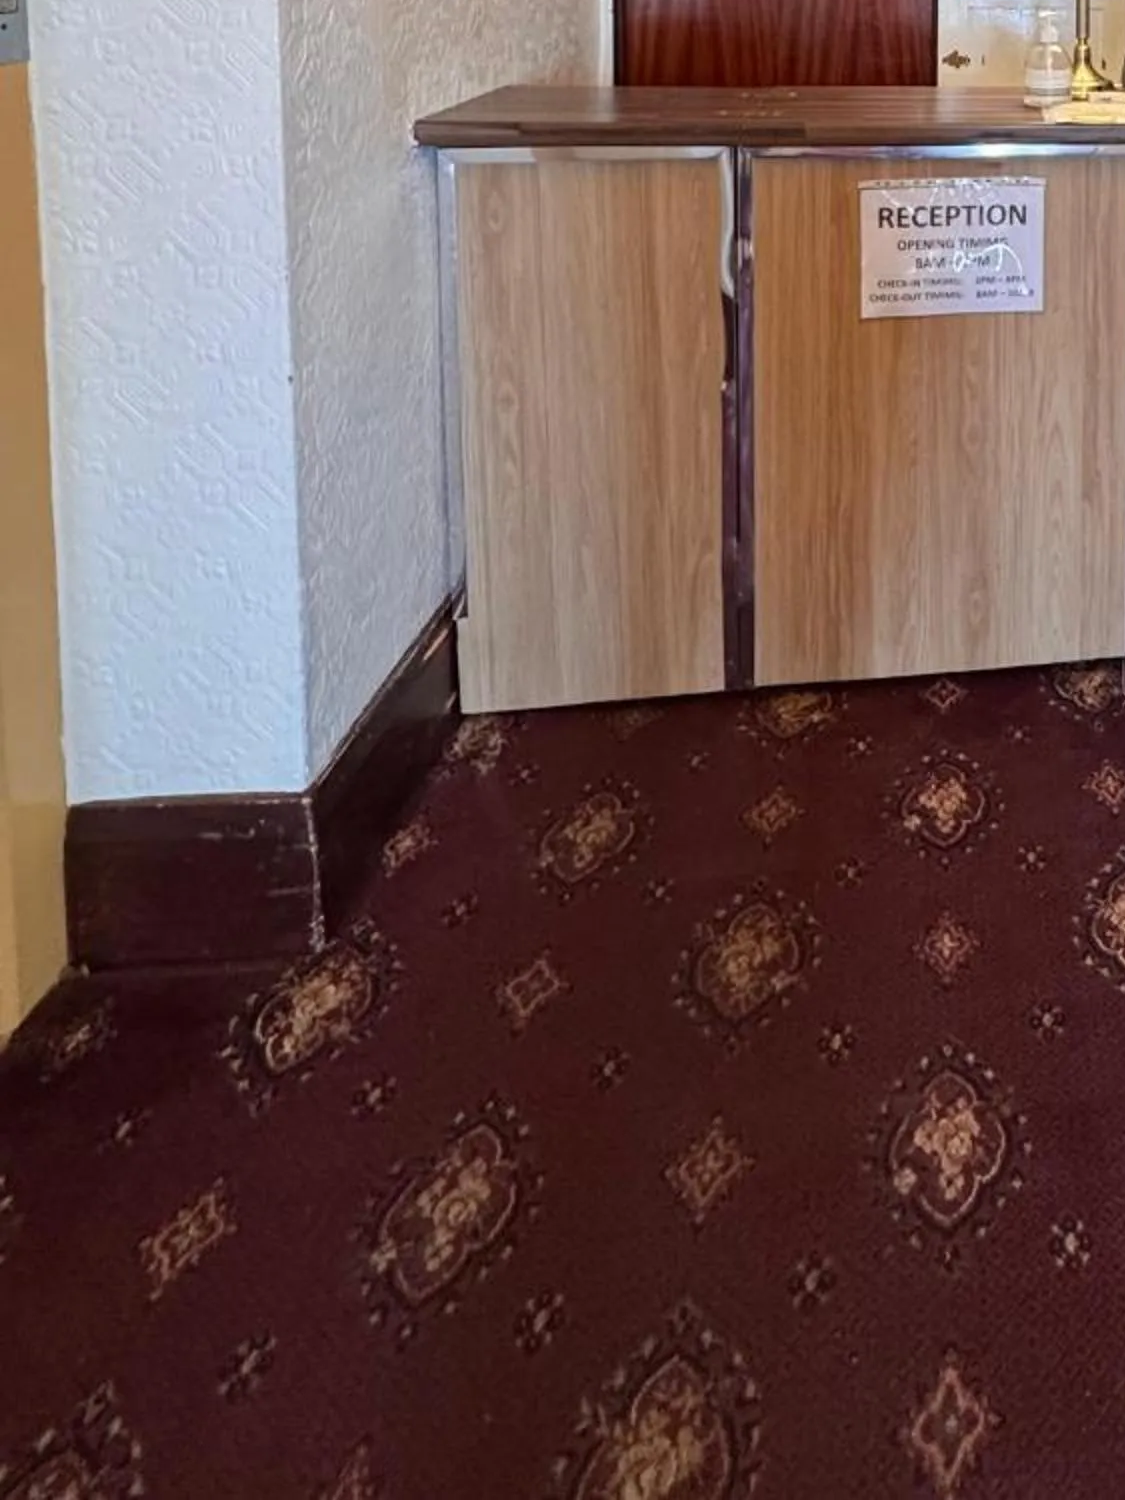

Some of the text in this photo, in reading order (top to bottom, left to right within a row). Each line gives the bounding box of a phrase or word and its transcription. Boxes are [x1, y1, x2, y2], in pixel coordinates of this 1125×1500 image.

[877, 203, 1028, 230] RECEPTION
[897, 238, 955, 251] OPENING
[876, 279, 921, 289] CHECK-IN
[869, 291, 921, 303] CHECK-OUT
